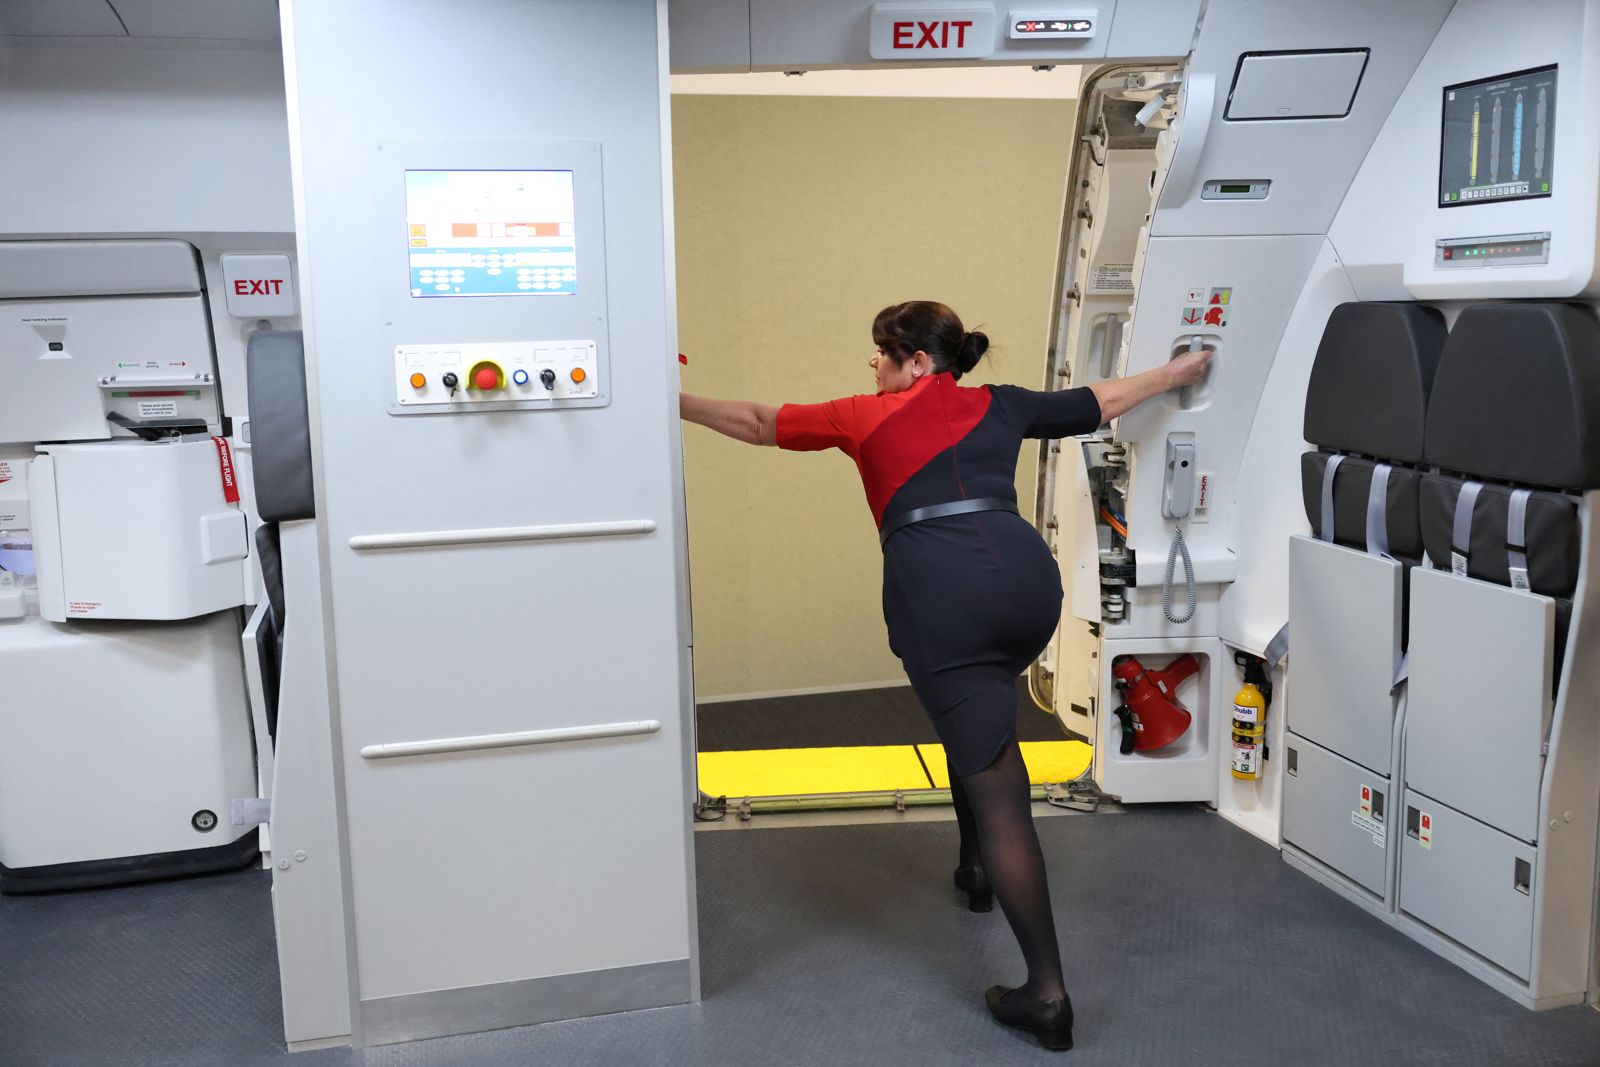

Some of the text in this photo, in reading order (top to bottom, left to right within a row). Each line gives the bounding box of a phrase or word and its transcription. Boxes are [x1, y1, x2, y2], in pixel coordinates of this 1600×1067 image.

[893, 21, 973, 49] EXIT
[234, 279, 283, 295] EXIT
[223, 467, 233, 487] FLIGHT
[1199, 475, 1208, 507] EXIT
